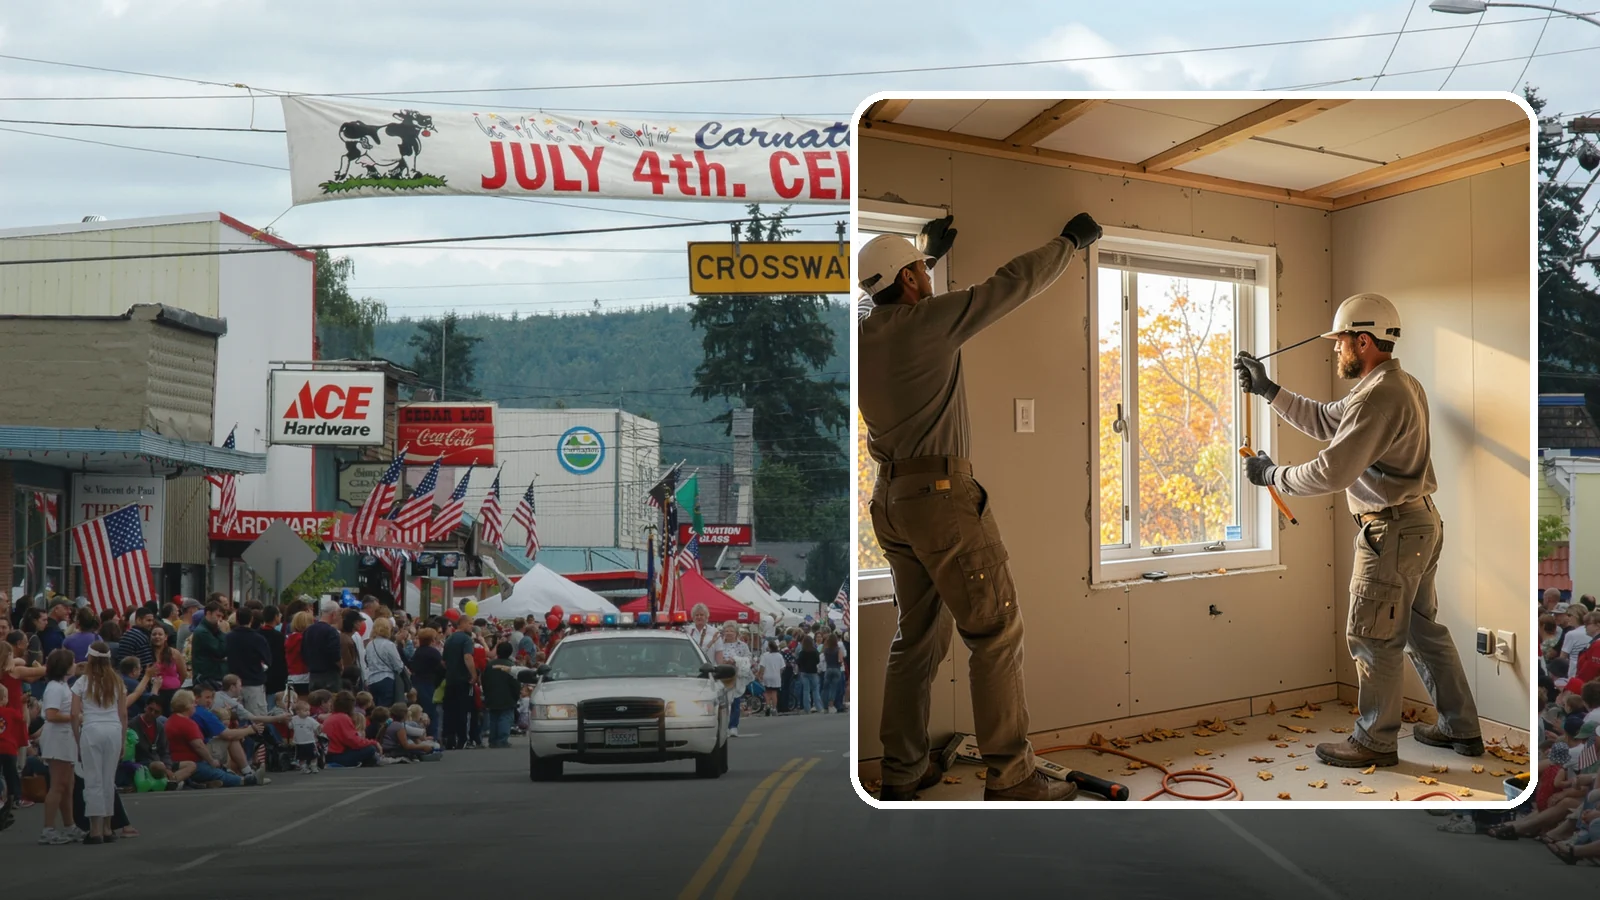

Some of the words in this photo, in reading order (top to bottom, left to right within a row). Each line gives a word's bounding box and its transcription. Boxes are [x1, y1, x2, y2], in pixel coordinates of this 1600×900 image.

[481, 141, 605, 193] JULY
[632, 150, 746, 197] 4th.
[697, 254, 850, 280] CROSSWA
[283, 380, 373, 420] ACE
[405, 409, 452, 422] CEDAR
[461, 409, 485, 422] LOG
[283, 421, 371, 437] Hardware
[353, 467, 384, 479] Simpl
[95, 484, 124, 495] Vincent
[126, 485, 135, 495] de
[138, 486, 155, 495] Paul
[212, 515, 331, 536] HARDARE
[688, 526, 742, 535] CRNATION
[699, 535, 730, 543] GLASS
